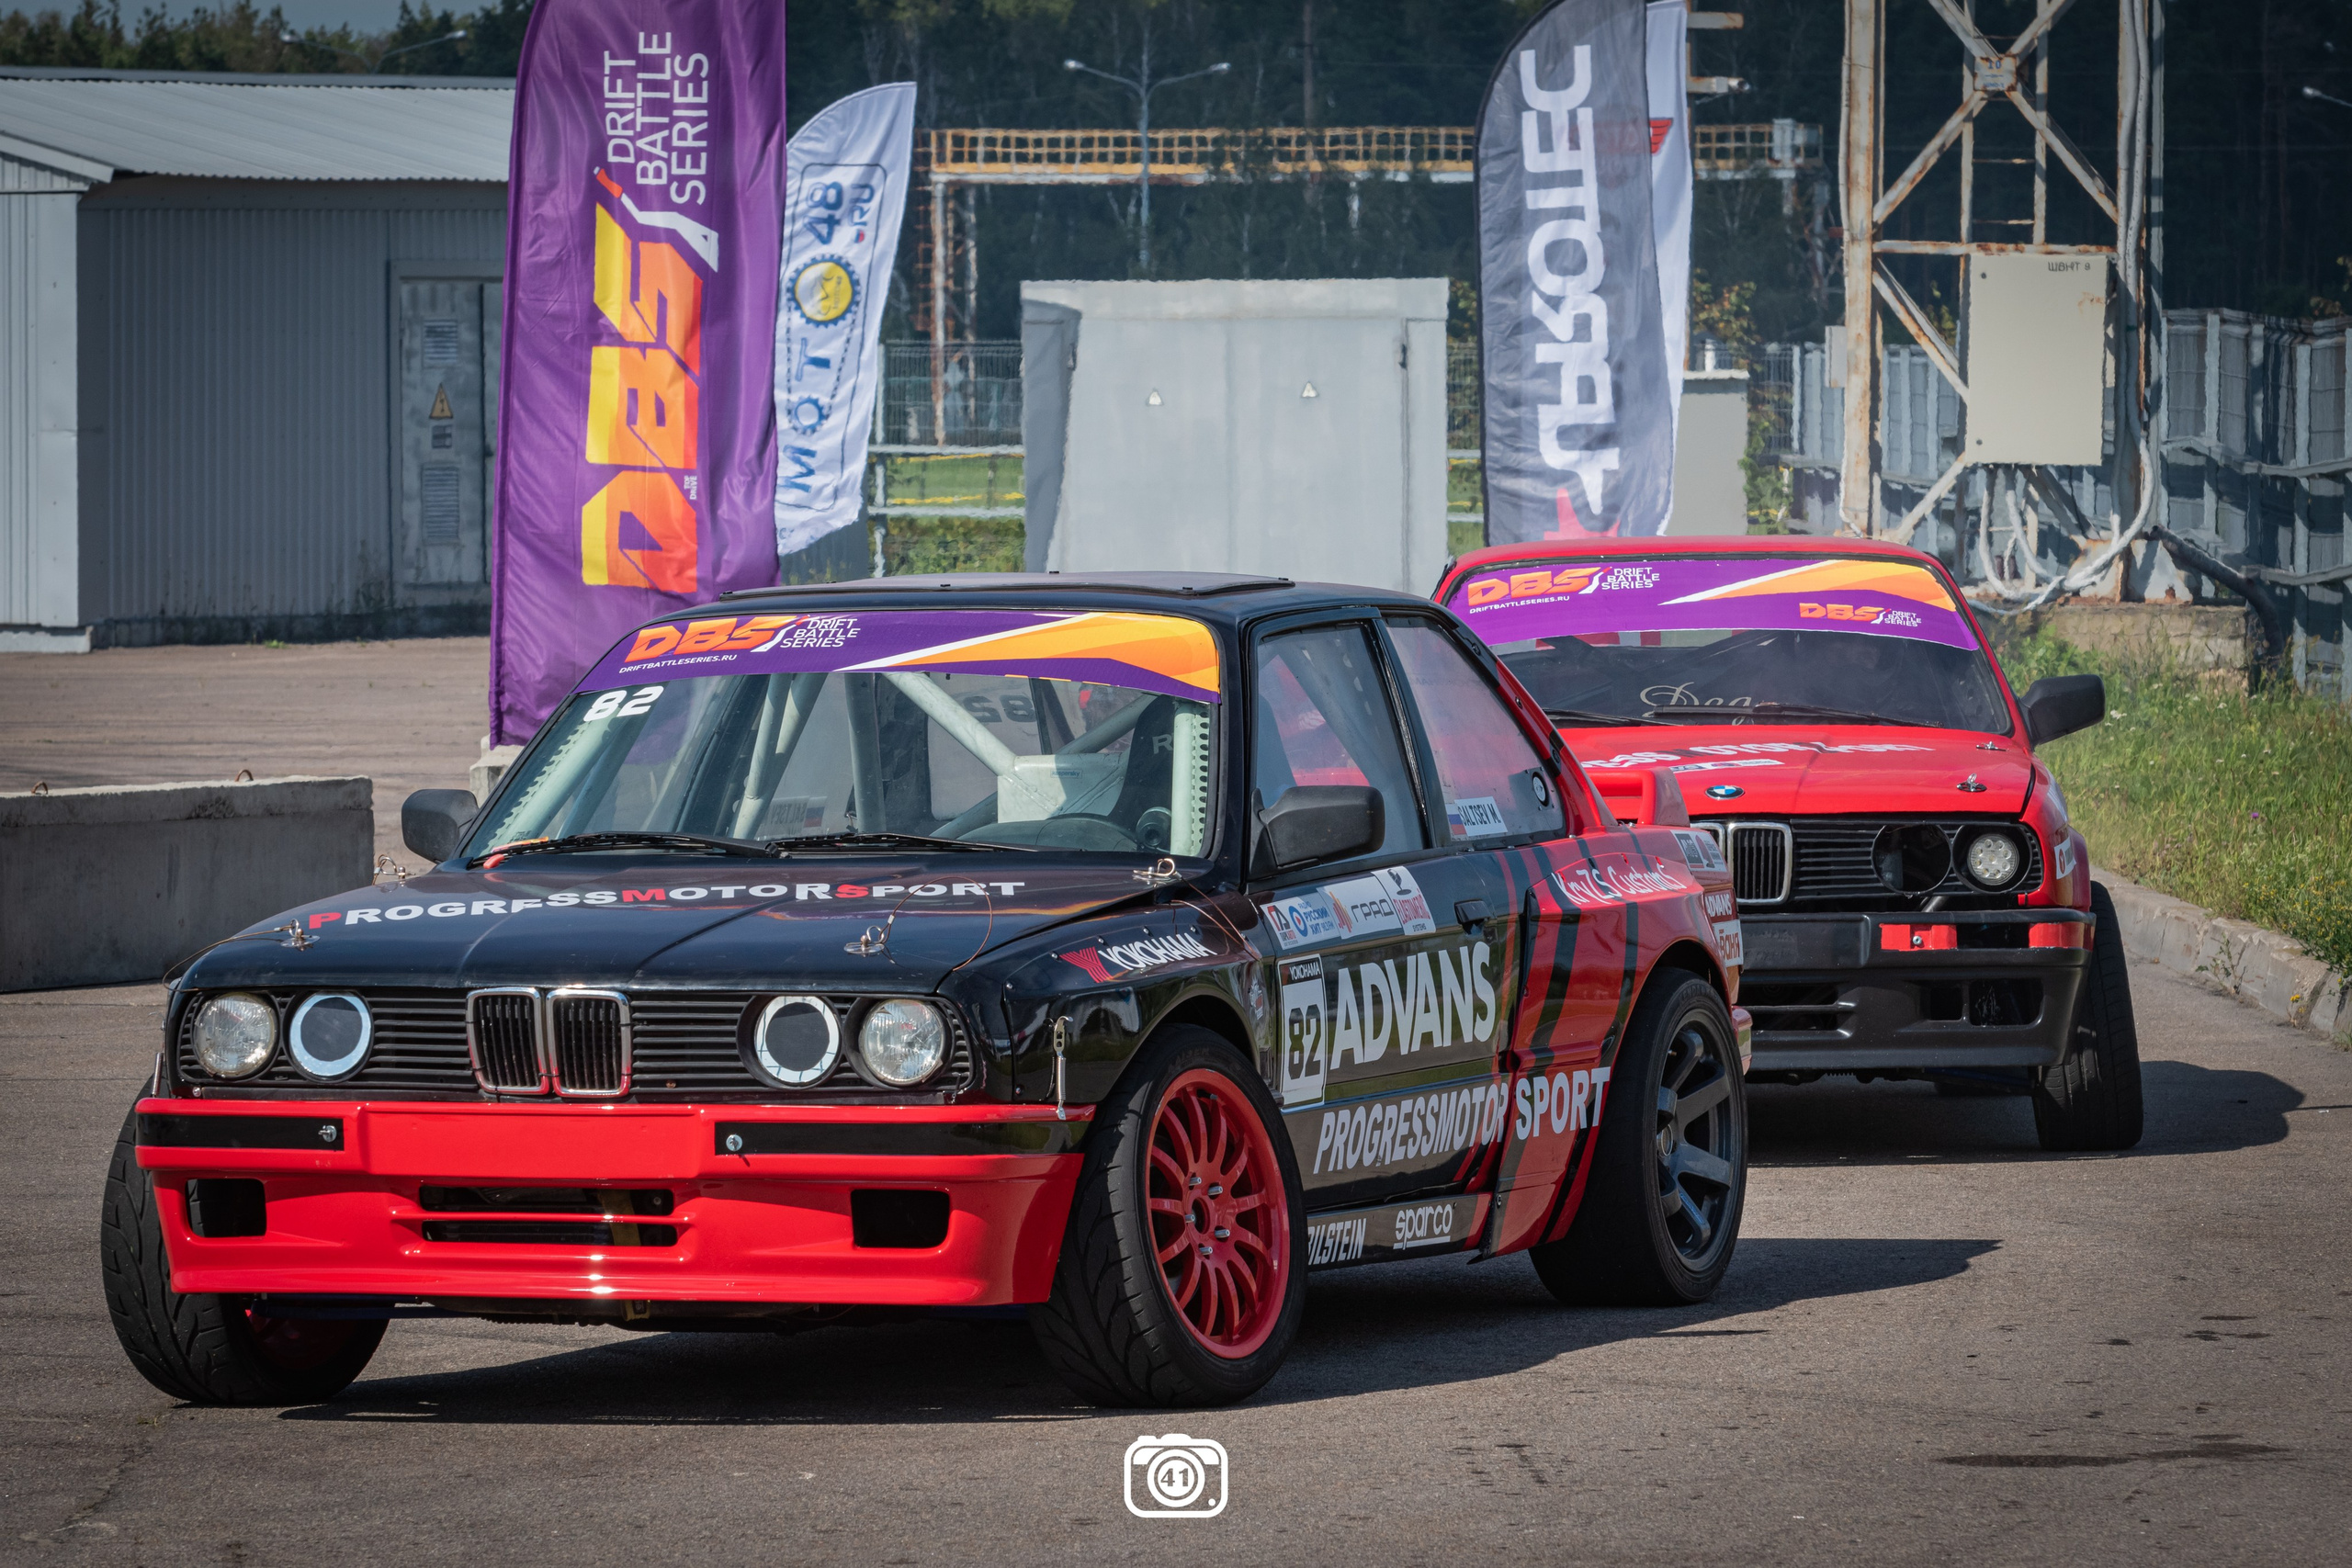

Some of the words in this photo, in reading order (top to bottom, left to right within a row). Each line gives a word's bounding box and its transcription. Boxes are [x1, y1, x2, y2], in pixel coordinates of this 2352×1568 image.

[603, 51, 636, 164] DRIFT
[638, 31, 672, 186] BATTLE
[670, 53, 708, 205] SERIES
[582, 202, 703, 593] DBS
[689, 475, 698, 500] DRIVE
[1607, 573, 1660, 583] BATTLE
[1613, 567, 1653, 576] DRIFT
[1468, 567, 1601, 606] DBS
[1601, 581, 1654, 590] SERIES
[1469, 595, 1570, 614] DRIFTBATTLESERIES.RU
[1799, 603, 1884, 622] DBS
[1892, 610, 1917, 618] DRIFT
[808, 618, 858, 630] DRIFT
[1883, 618, 1918, 627] SERIES
[1888, 615, 1922, 624] BATTLE
[625, 615, 797, 662] DBS
[780, 637, 845, 648] SERIES
[793, 628, 862, 639] BATTLE
[618, 654, 738, 673] DRIFTBATTLESERIES.RU
[582, 685, 664, 722] 82
[1458, 804, 1491, 827] SALTSEV
[308, 881, 1025, 930] PROGRESSMOTORSPORT
[1351, 898, 1395, 923] ГРАД
[1705, 893, 1732, 917] ADVANS
[1098, 932, 1217, 970] YOKOHAMA
[1289, 962, 1321, 980] YOKOHAMA
[1330, 942, 1496, 1070] ADVANS
[1288, 1004, 1321, 1080] 82
[1516, 1066, 1611, 1140] SPORT
[1395, 1203, 1453, 1250] sparco
